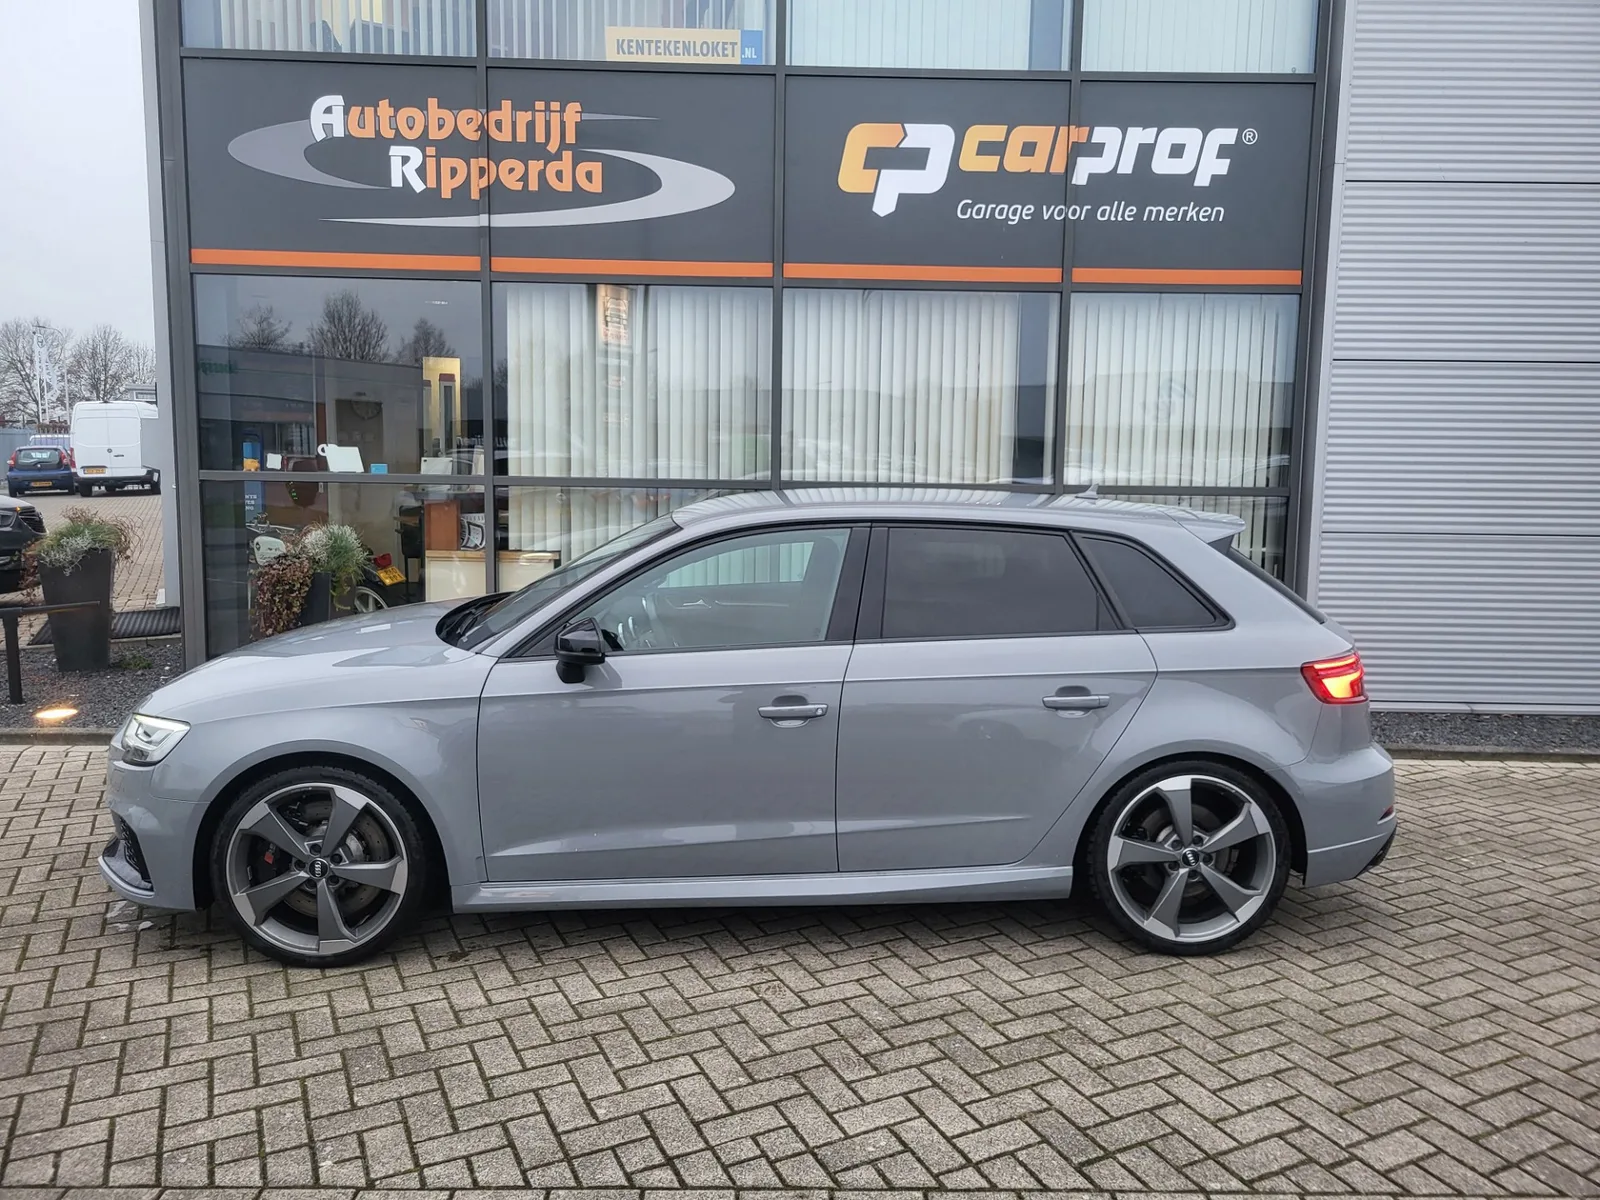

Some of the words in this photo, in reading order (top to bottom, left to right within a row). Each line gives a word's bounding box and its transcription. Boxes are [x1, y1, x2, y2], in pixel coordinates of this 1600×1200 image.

[616, 38, 738, 58] KENTEKENLOKET
[310, 95, 583, 152] Autobedrijf
[388, 145, 603, 200] Ripperda
[956, 199, 1035, 225] Garage
[1042, 203, 1091, 222] voor
[1096, 200, 1137, 222] alle
[1142, 202, 1225, 223] merken
